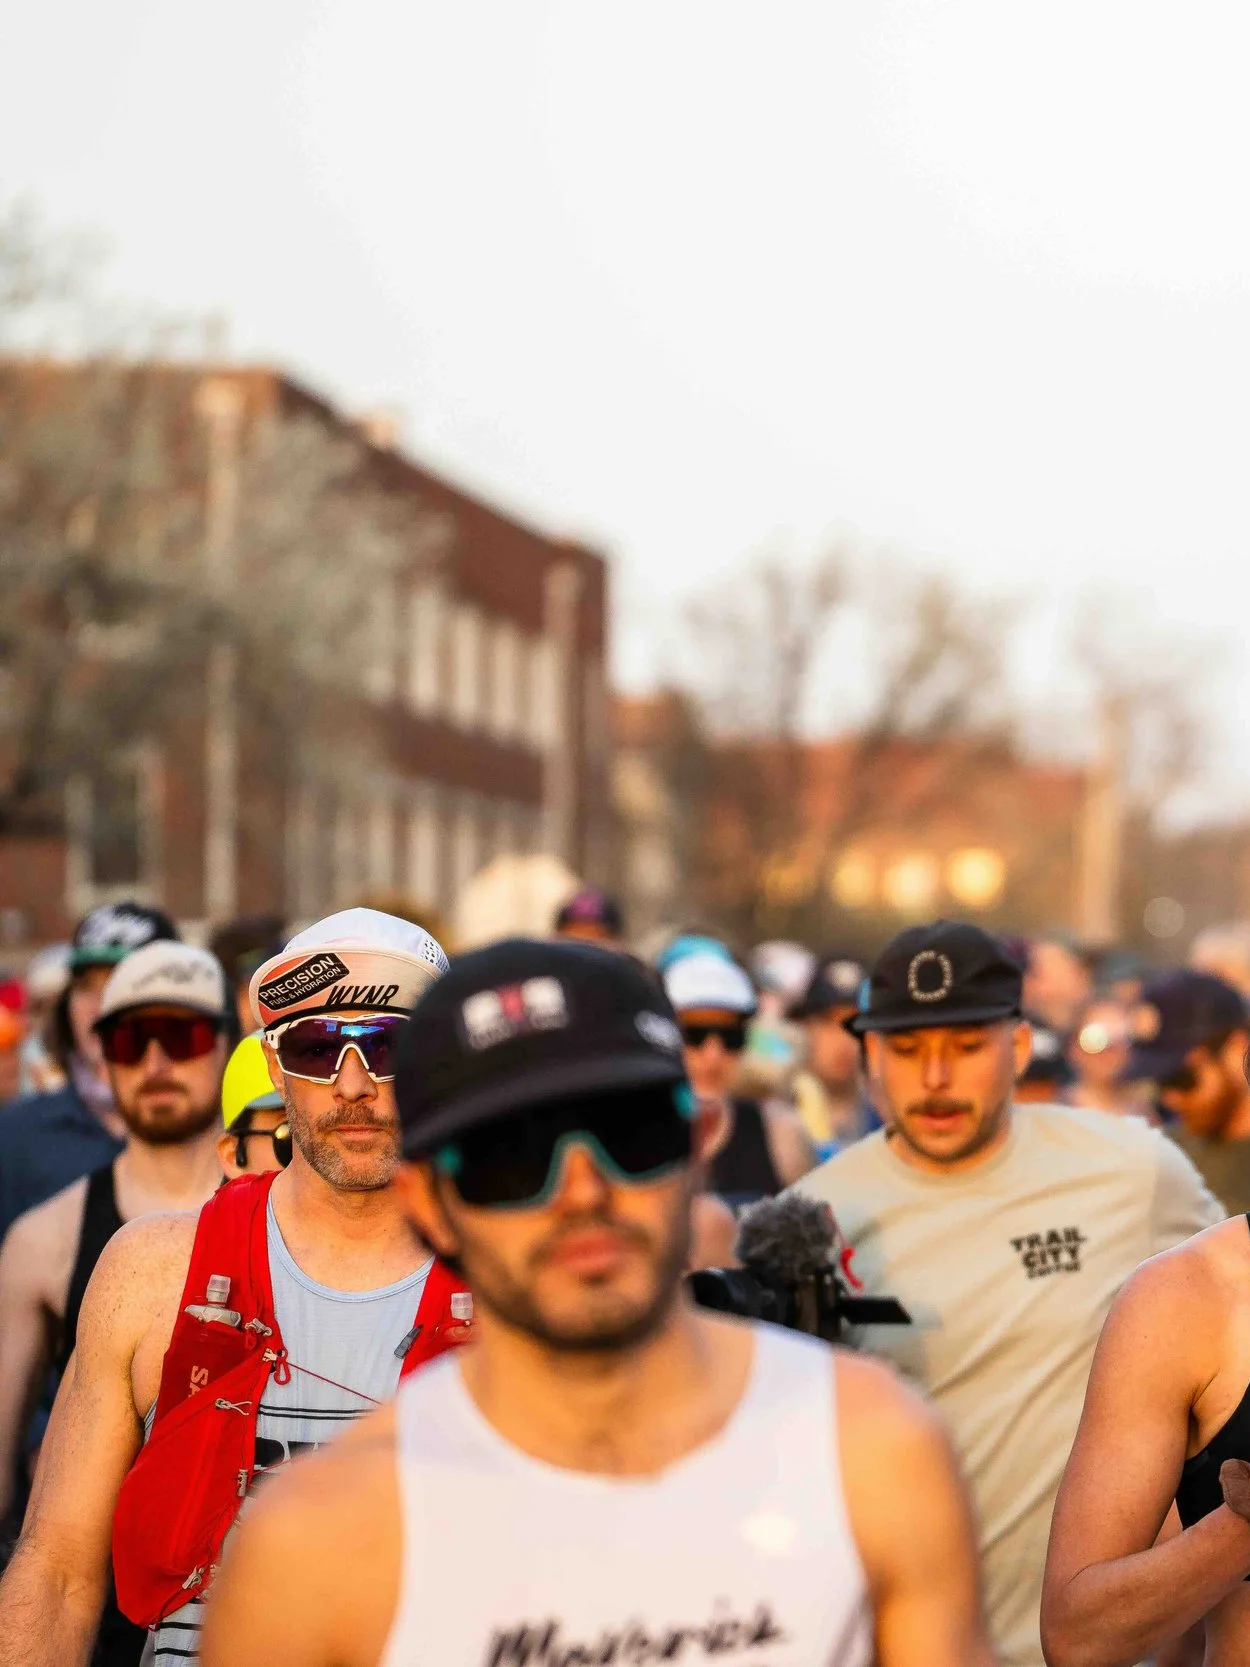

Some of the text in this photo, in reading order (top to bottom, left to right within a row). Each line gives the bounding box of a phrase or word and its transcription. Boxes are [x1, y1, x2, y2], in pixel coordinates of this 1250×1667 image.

[260, 956, 335, 1001] PRECISION
[269, 967, 341, 1007] FUEL & HYDRATION
[325, 984, 400, 1006] WYNR
[1010, 1227, 1087, 1252] TRAIL
[1023, 1244, 1079, 1269] CITY
